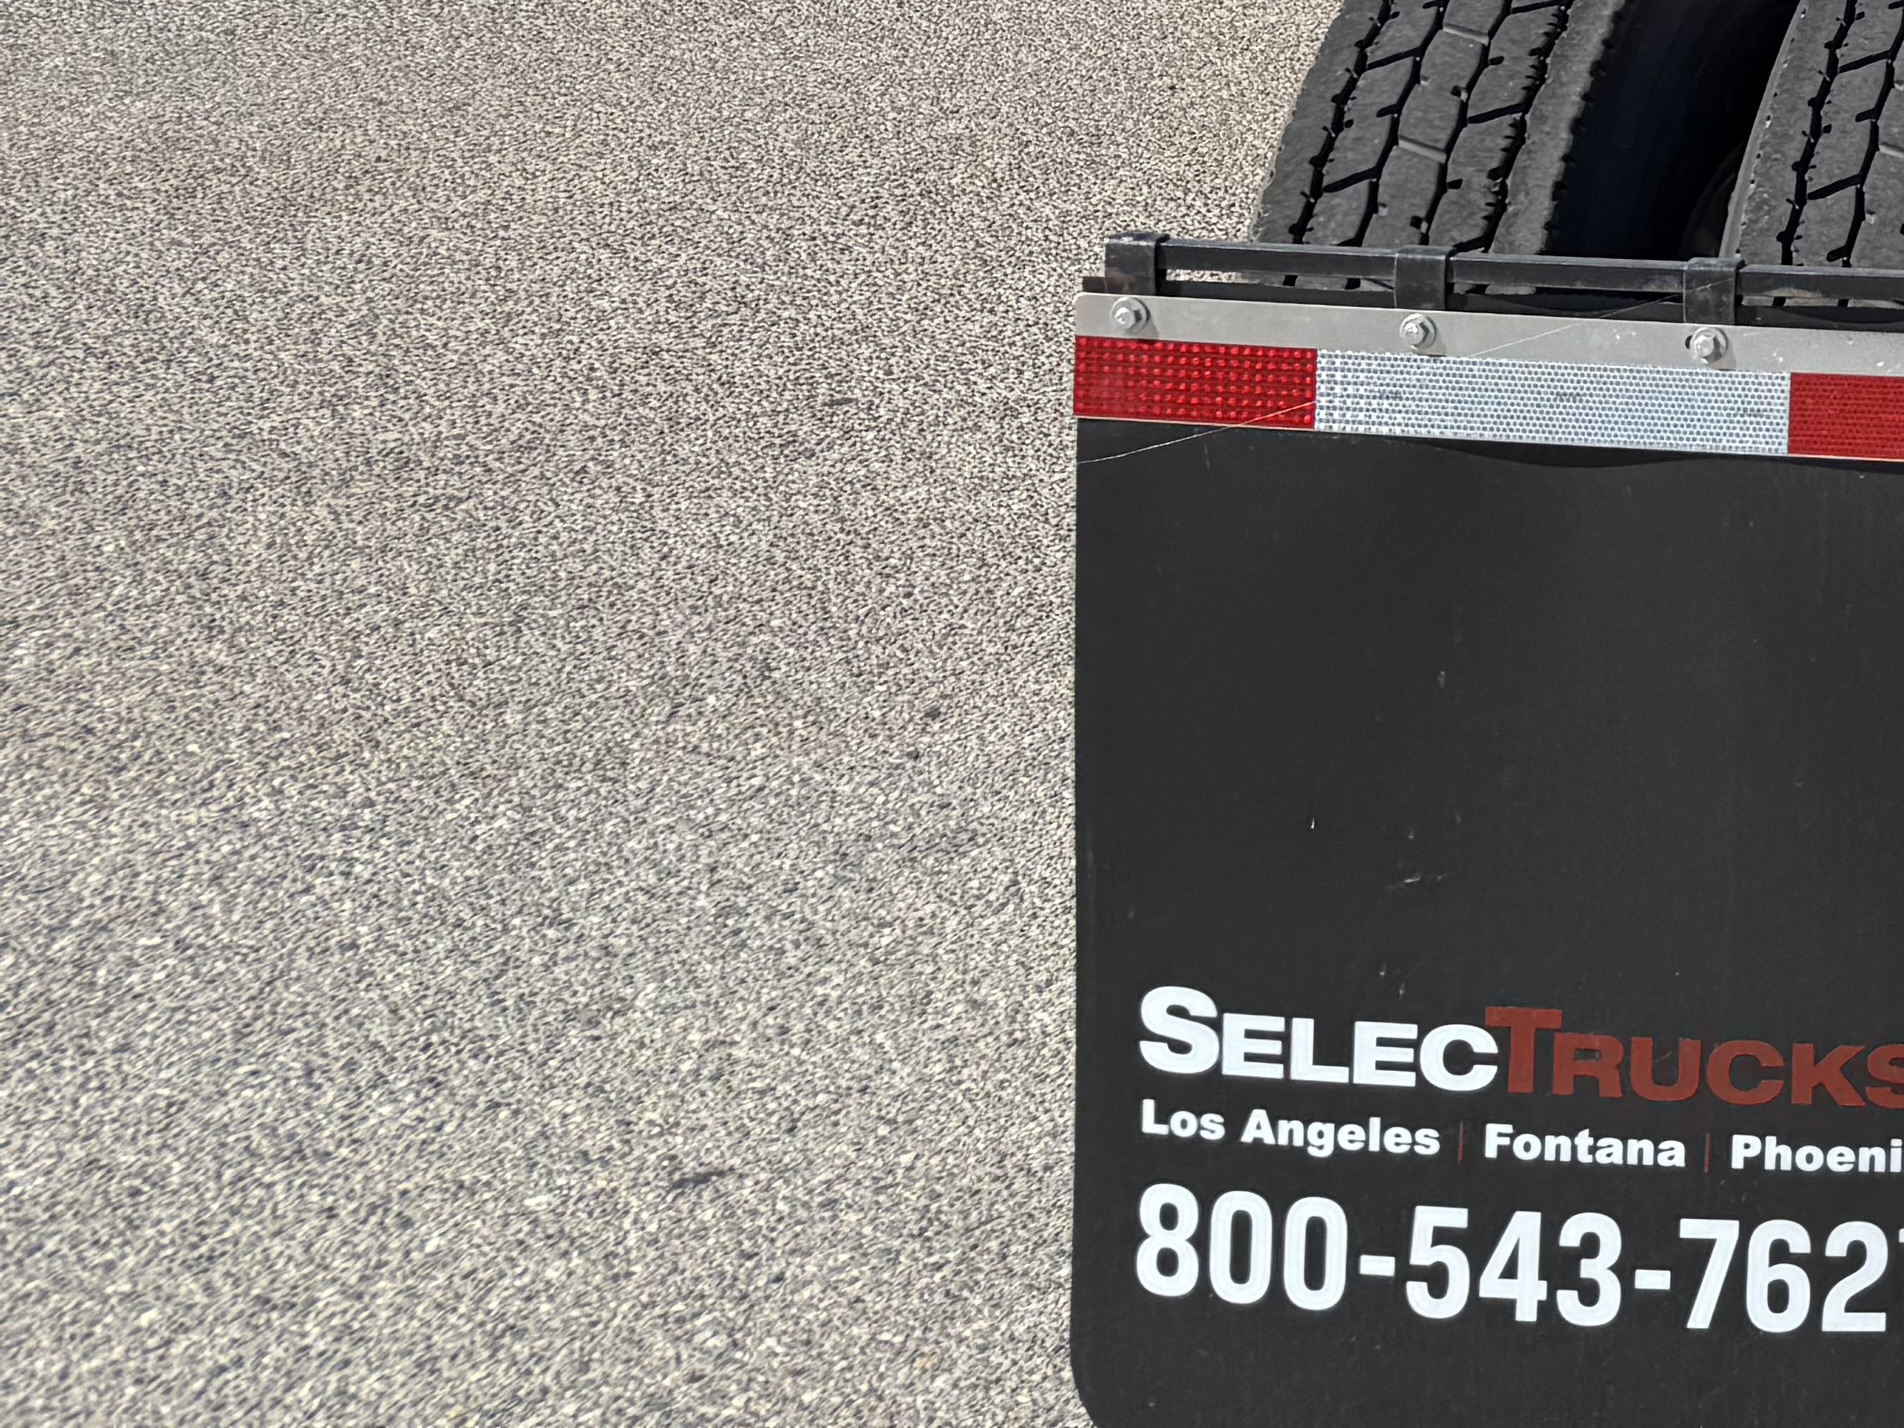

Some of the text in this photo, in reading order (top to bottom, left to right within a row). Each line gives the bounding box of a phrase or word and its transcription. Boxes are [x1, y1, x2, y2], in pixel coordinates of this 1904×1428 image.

[1141, 1098, 1226, 1142] Los
[1240, 1108, 1441, 1158] Angeles
[1484, 1122, 1686, 1168] Fontana
